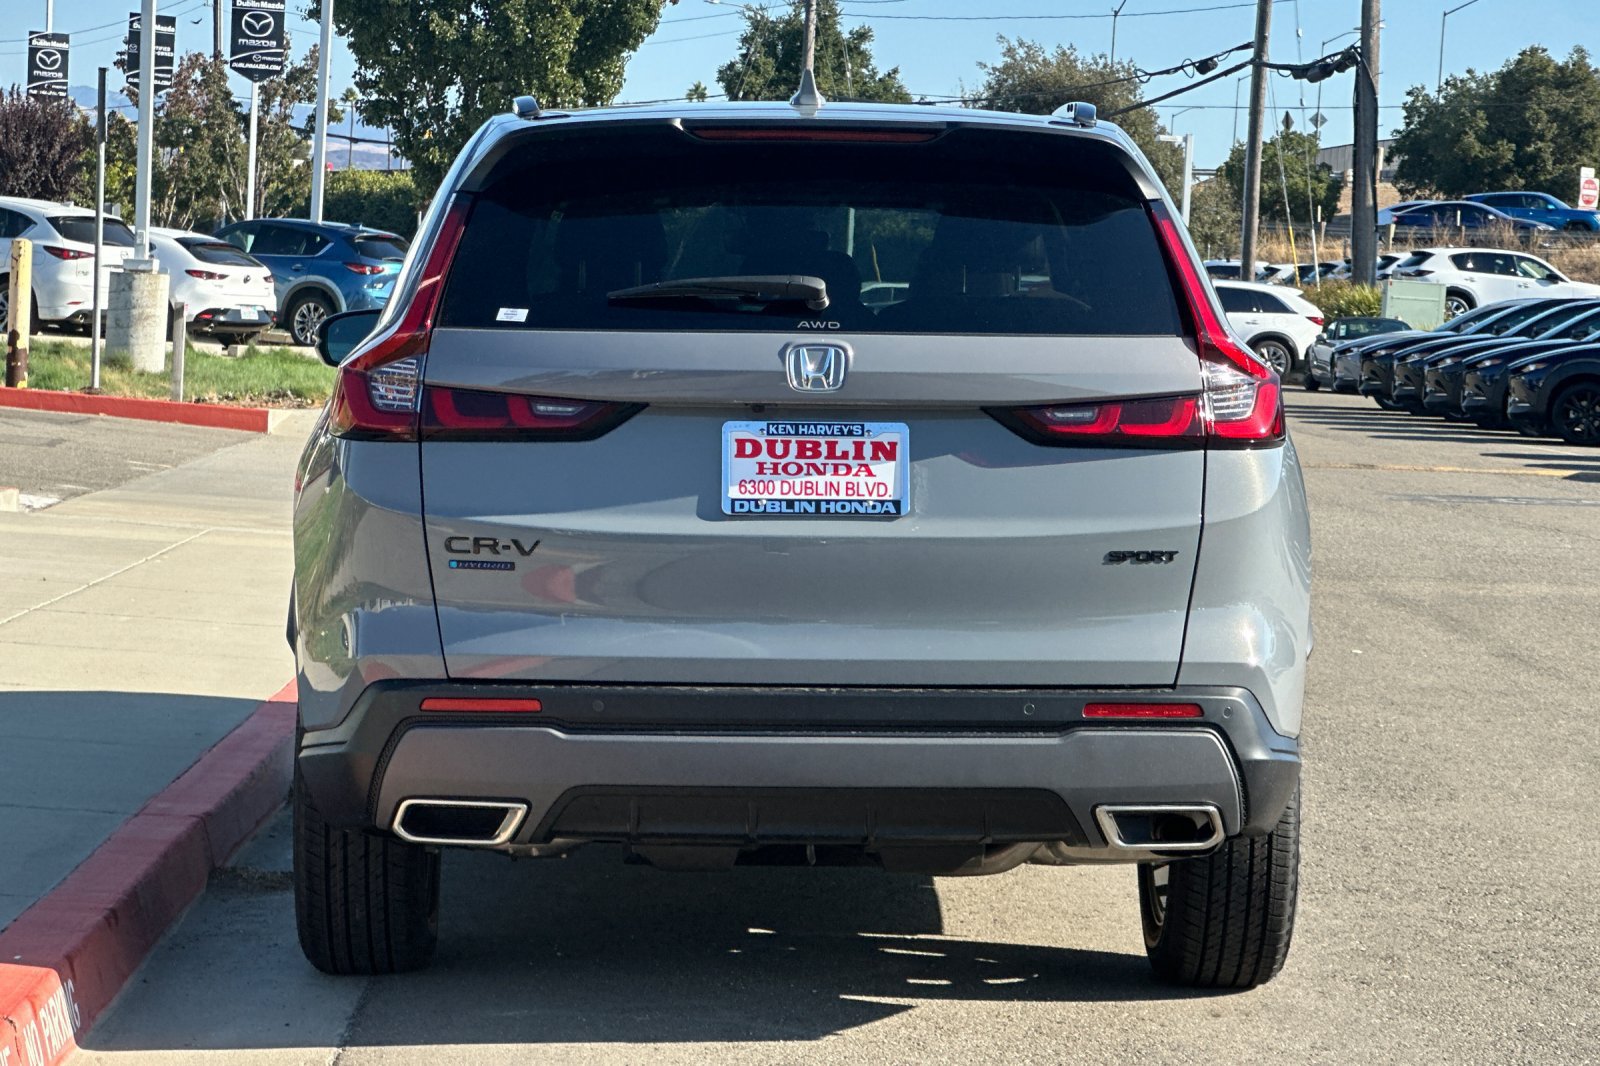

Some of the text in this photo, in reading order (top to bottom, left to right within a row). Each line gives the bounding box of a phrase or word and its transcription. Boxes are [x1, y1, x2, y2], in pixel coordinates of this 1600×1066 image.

[260, 2, 285, 10] Mazda
[797, 321, 840, 329] AWD
[769, 424, 862, 436] KEN HARVEY'S
[734, 438, 898, 462] DUBLIN
[756, 461, 876, 477] HONDA
[738, 479, 892, 498] 6300 DUBLIN BLVD.
[734, 500, 897, 514] DUBLIN HONDA
[444, 536, 541, 557] CR-V
[1103, 550, 1180, 563] SPORT
